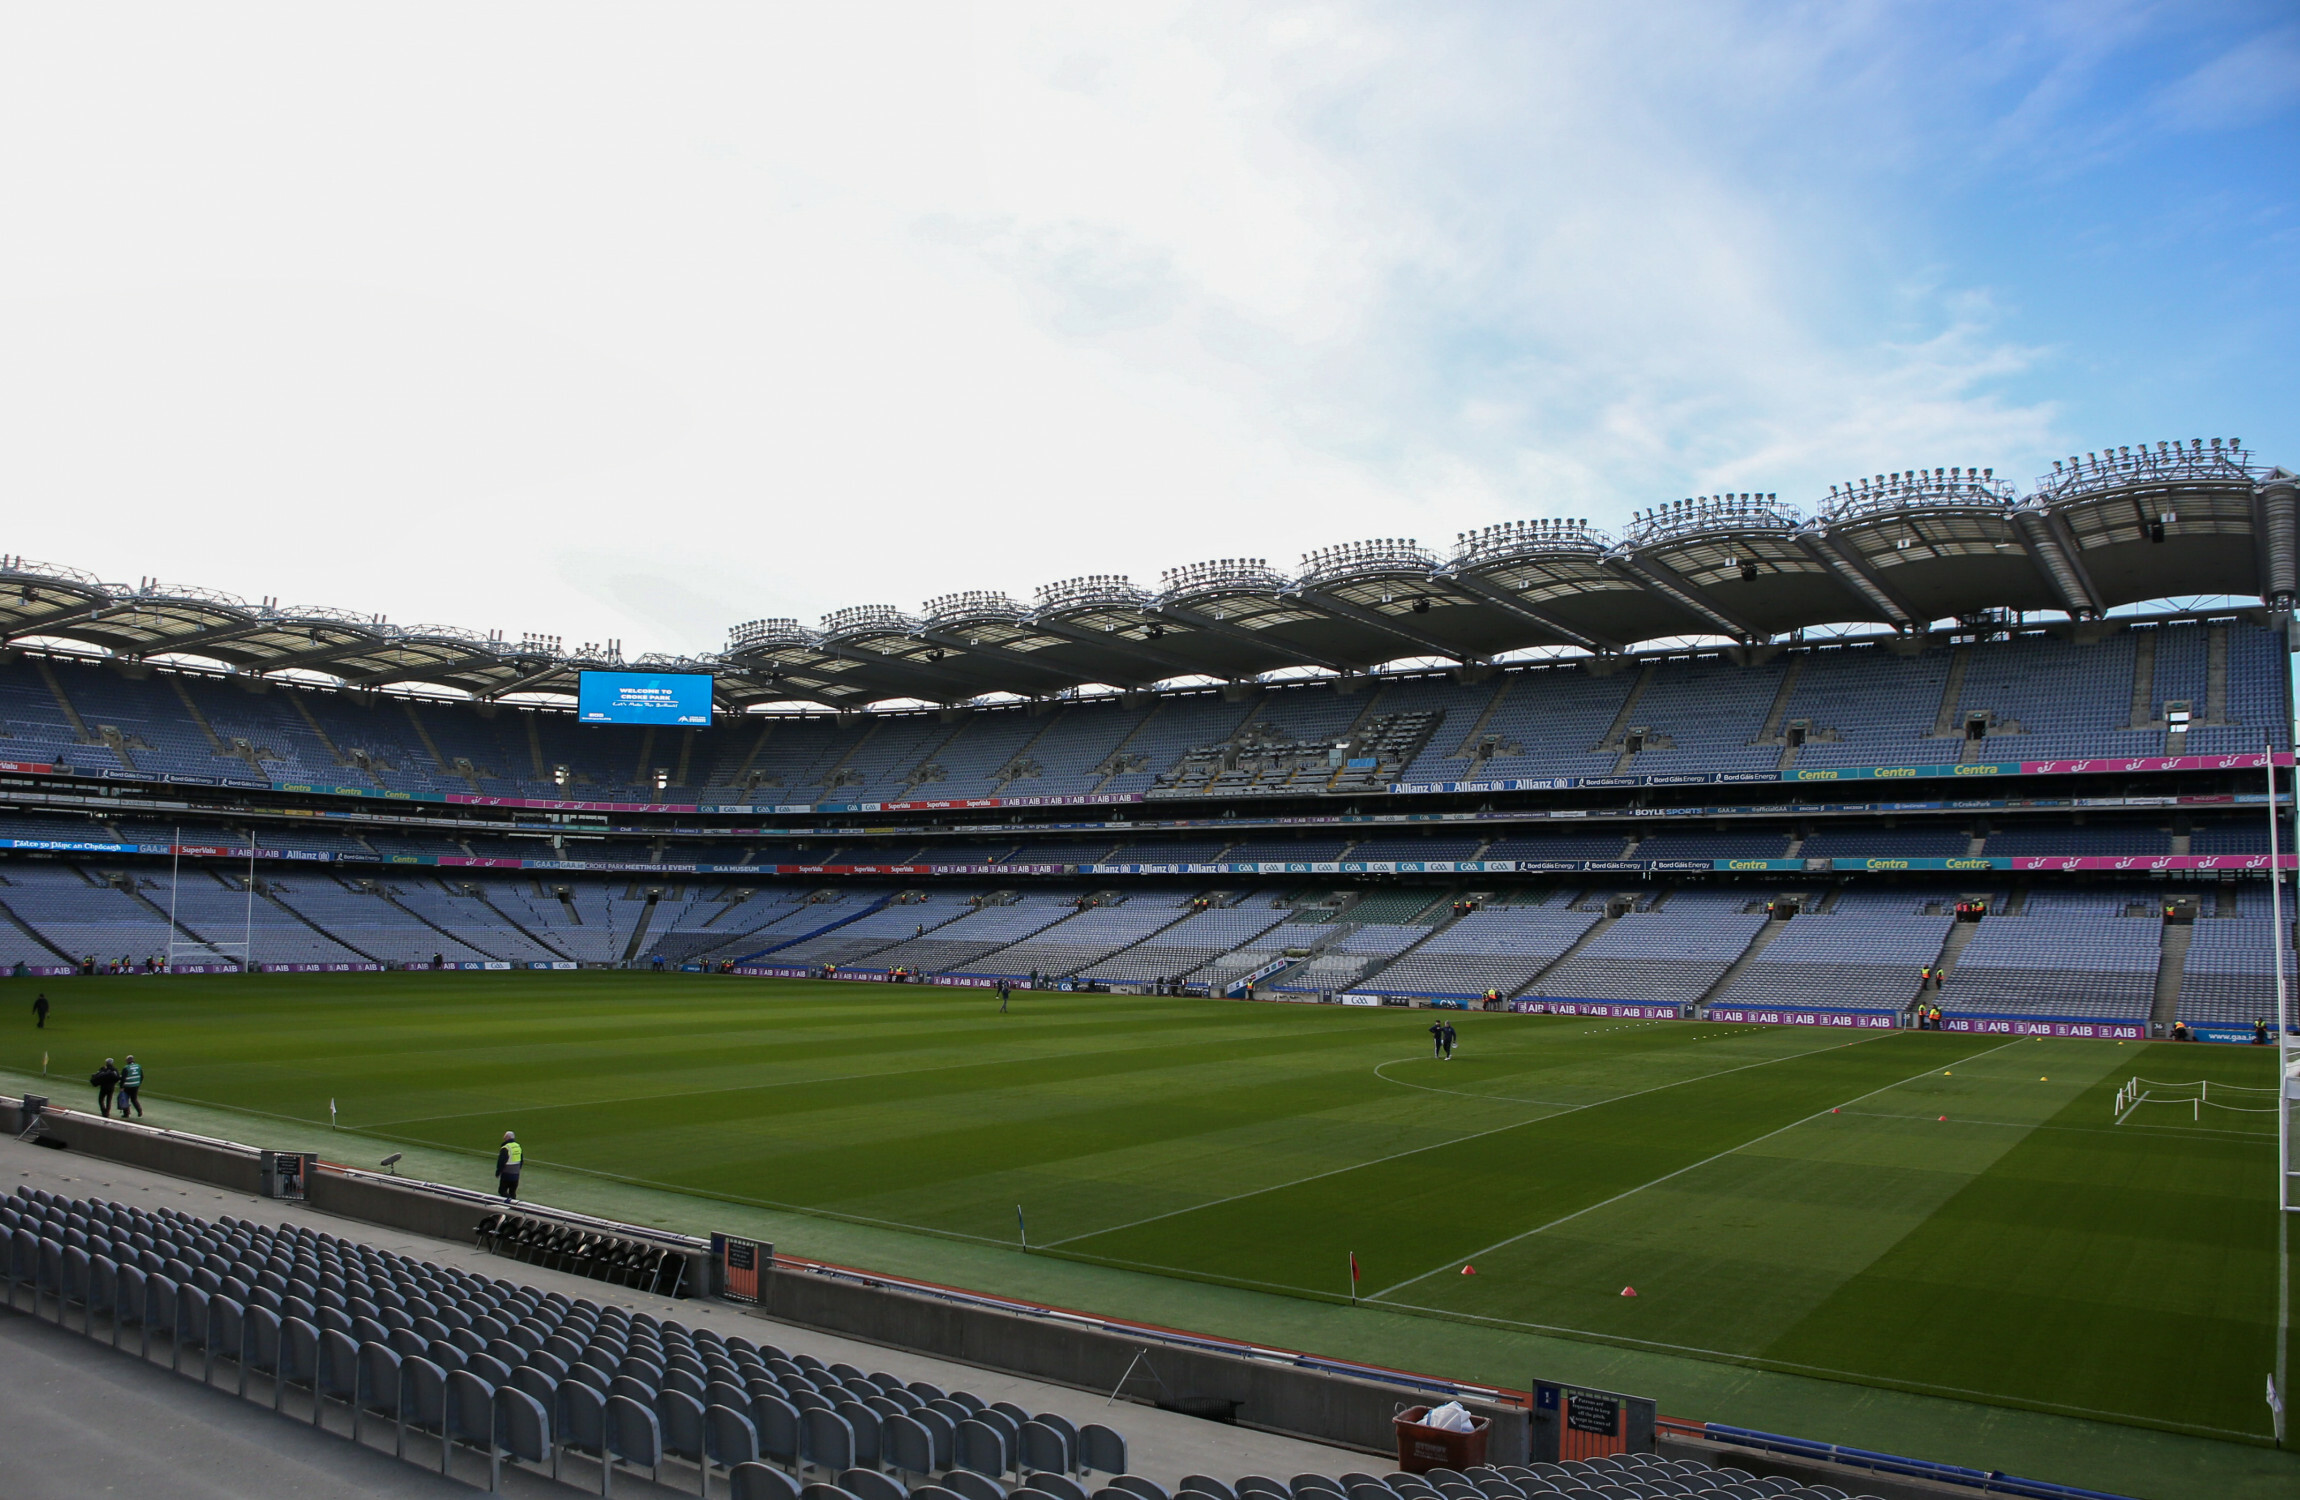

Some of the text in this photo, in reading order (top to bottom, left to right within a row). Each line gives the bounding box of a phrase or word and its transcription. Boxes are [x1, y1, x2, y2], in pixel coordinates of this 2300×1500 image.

[2071, 759, 2090, 772] eir
[2125, 758, 2145, 770] eir
[2161, 757, 2181, 770] eir
[2219, 755, 2240, 768] eir
[2253, 754, 2268, 767] ei
[1874, 767, 1916, 777] Centra
[1954, 765, 1998, 775] Centra
[2037, 761, 2056, 773] eir
[1683, 776, 1705, 784] Energy
[1754, 773, 1778, 781] Energy
[1798, 770, 1838, 780] Centra
[1454, 781, 1488, 792] Allianz
[1515, 779, 1552, 789] Allianz
[1601, 777, 1614, 785] Gáis
[1614, 778, 1635, 786] Energy
[283, 783, 311, 792] Centra
[335, 786, 363, 796] Centra
[1395, 784, 1429, 793] Allianz
[384, 790, 410, 799] Centra
[888, 802, 910, 810] SuperValu
[140, 844, 168, 853] GAA.ie
[182, 846, 216, 855] SuperValu
[265, 850, 279, 858] AIB
[286, 850, 317, 860] Allianz
[1542, 861, 1554, 869] Gáis
[1554, 862, 1575, 870] Energy
[1606, 861, 1619, 869] Gáis
[1620, 862, 1641, 870] Energy
[1688, 861, 1710, 869] Energy
[1729, 860, 1767, 869] Centra
[1867, 859, 1908, 869] Centra
[2028, 858, 2046, 869] eir
[2062, 857, 2081, 869] eir
[2115, 857, 2135, 869] eir
[2152, 857, 2172, 869] eir
[2198, 856, 2219, 868] eir
[2246, 856, 2268, 868] eir
[891, 866, 914, 874] SuperValu
[1092, 865, 1119, 873] Allianz
[1139, 864, 1166, 873] Allianz
[1187, 864, 1215, 873] Allianz
[189, 965, 204, 973] AIB
[960, 978, 971, 986] AIB
[1559, 1005, 1575, 1014] AIB
[1590, 1007, 1607, 1016] AIB
[1623, 1008, 1640, 1017] AIB
[1656, 1009, 1673, 1018] AIB
[1725, 1012, 1742, 1021] AIB
[1760, 1013, 1778, 1022] AIB
[1795, 1014, 1814, 1024] AIB
[1832, 1015, 1852, 1026] AIB
[1870, 1017, 1889, 1027] AIB
[1948, 1021, 1969, 1031] AIB
[1988, 1022, 2009, 1032] AIB
[2028, 1024, 2050, 1034] AIB
[2070, 1025, 2092, 1036] AIB
[2114, 1027, 2136, 1038] AIB
[2208, 1032, 2256, 1042] www.gaa.ie
